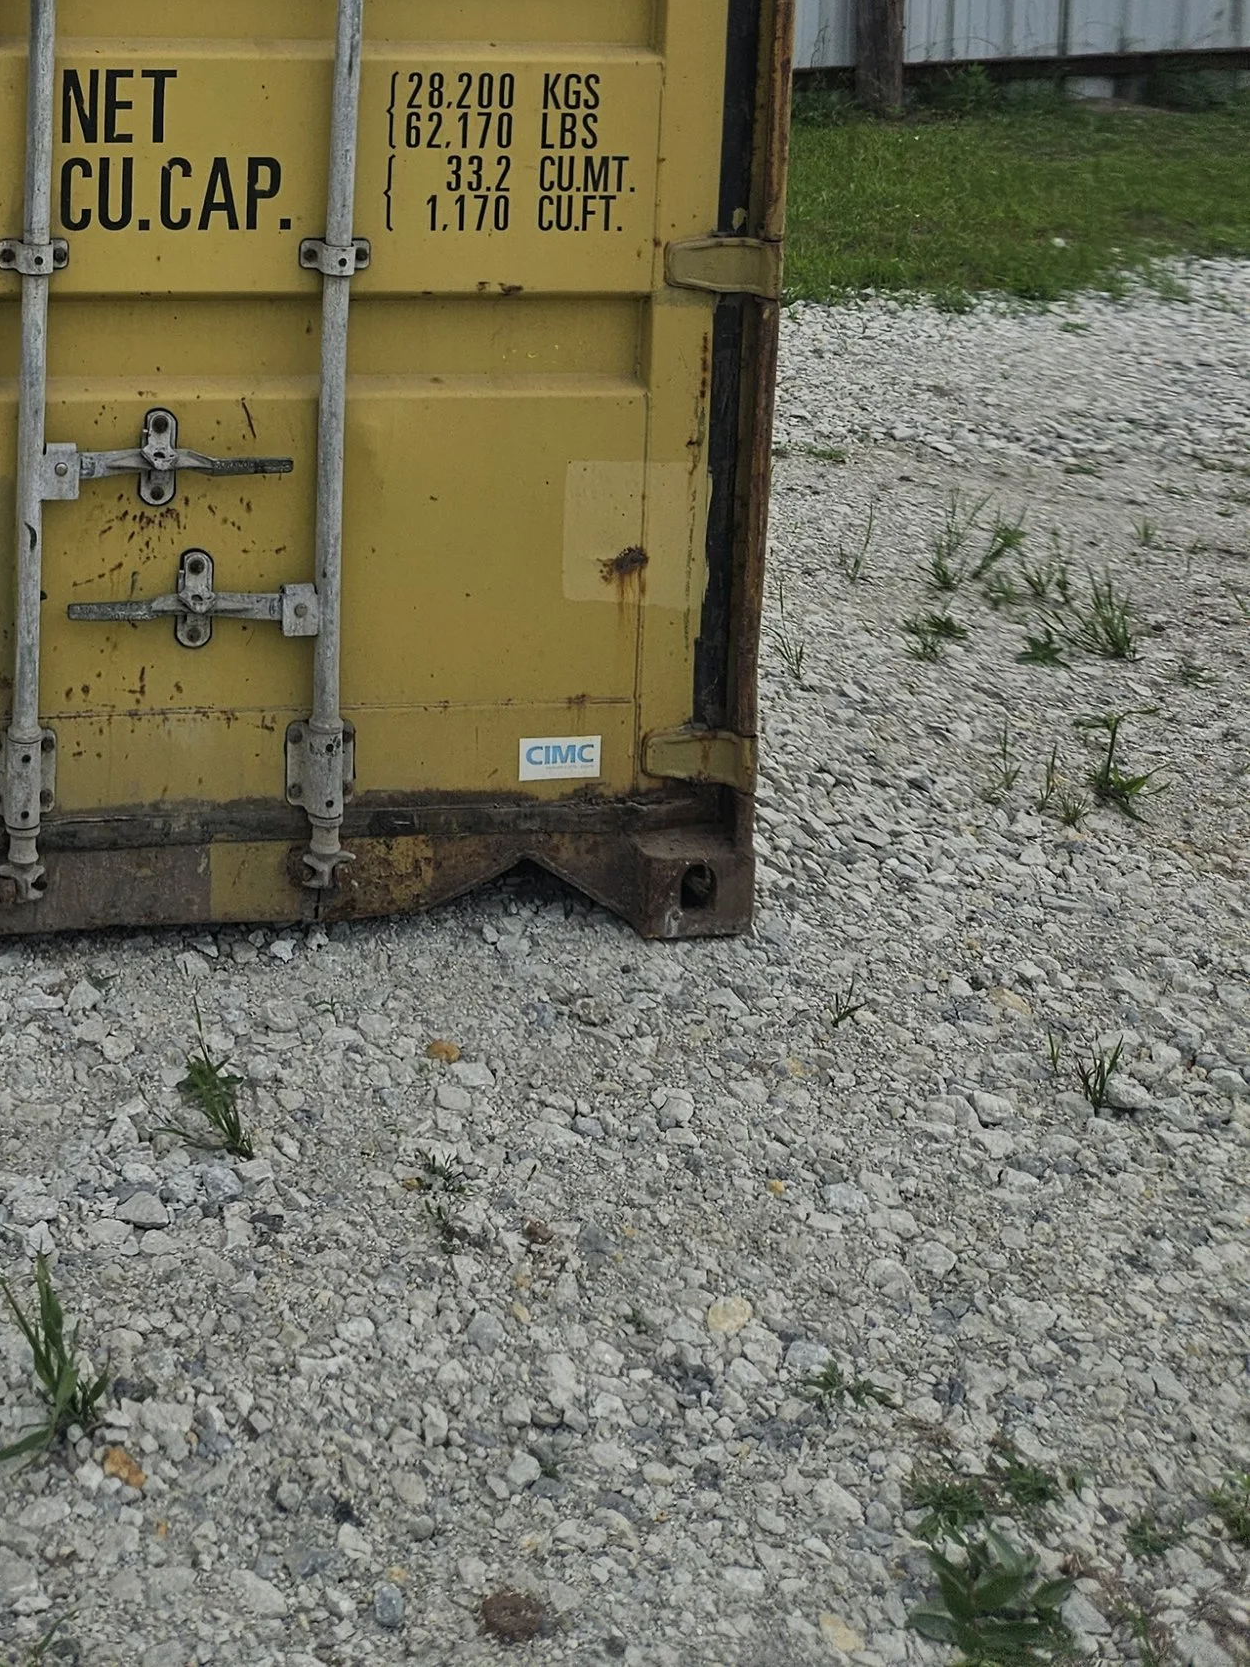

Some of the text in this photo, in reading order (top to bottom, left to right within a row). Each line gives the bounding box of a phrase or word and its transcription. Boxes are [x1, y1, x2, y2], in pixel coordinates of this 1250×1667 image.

[62, 69, 177, 143] NET
[407, 72, 599, 109] 28,200 KGS
[406, 112, 597, 149] 62,170 LBS
[447, 155, 636, 193] 33.2 CU.MT.
[60, 157, 291, 231] CU.CAP.
[427, 195, 622, 232] 1,170 CU.FT.
[525, 743, 594, 766] CIMC
